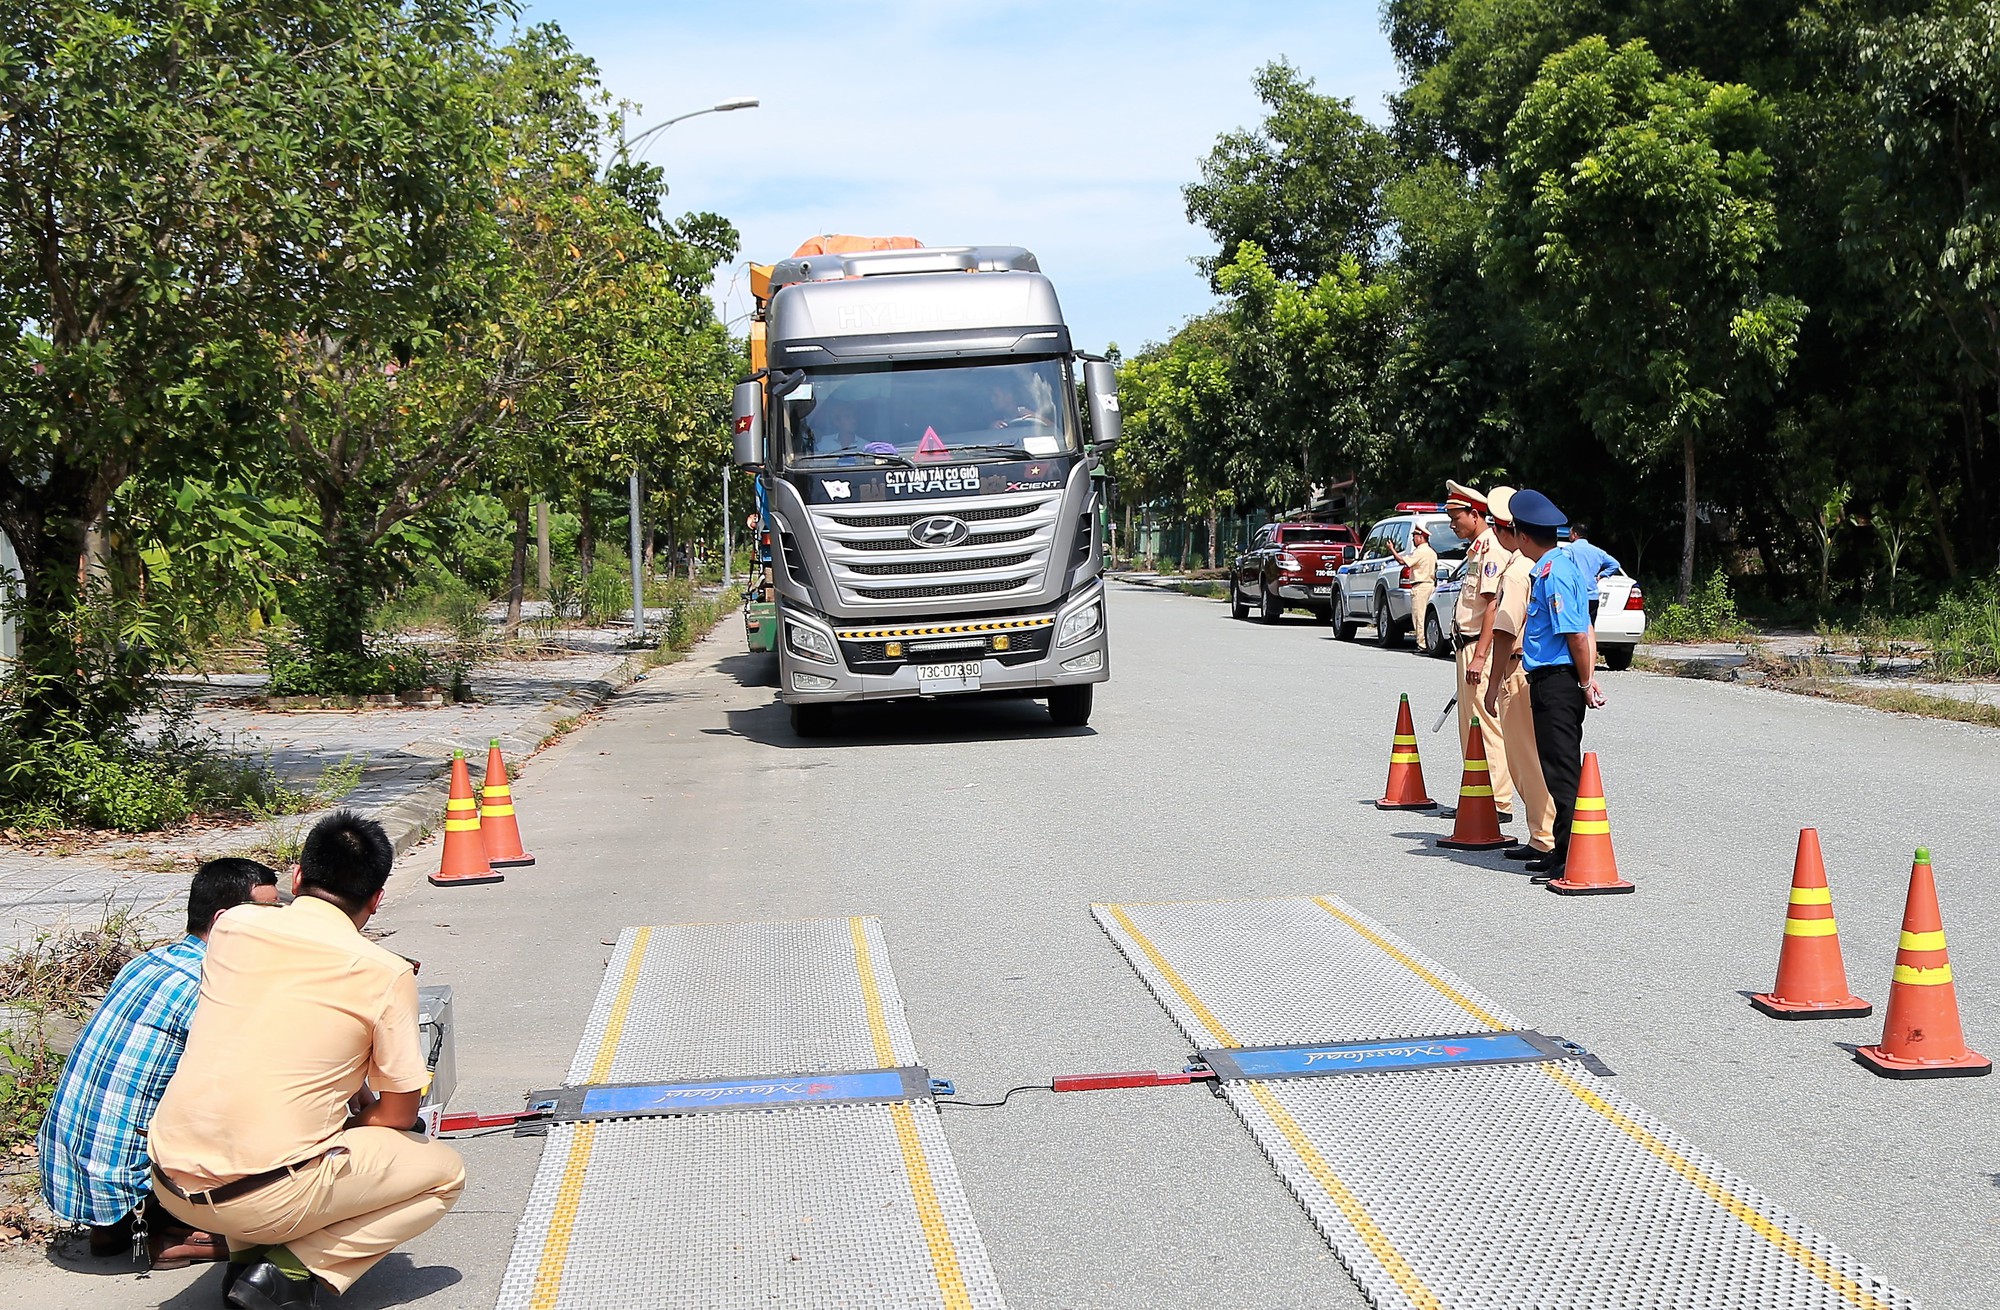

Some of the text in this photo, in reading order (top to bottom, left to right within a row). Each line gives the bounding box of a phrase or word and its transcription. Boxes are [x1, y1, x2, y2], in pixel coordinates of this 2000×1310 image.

[885, 471, 906, 484] C.TY
[945, 467, 959, 480] CƠ
[960, 464, 979, 480] GIỚI
[886, 478, 980, 494] TRAGO
[1004, 480, 1060, 492] XCIENT
[1303, 1046, 1443, 1065] Massload
[652, 1083, 806, 1104] Massload
